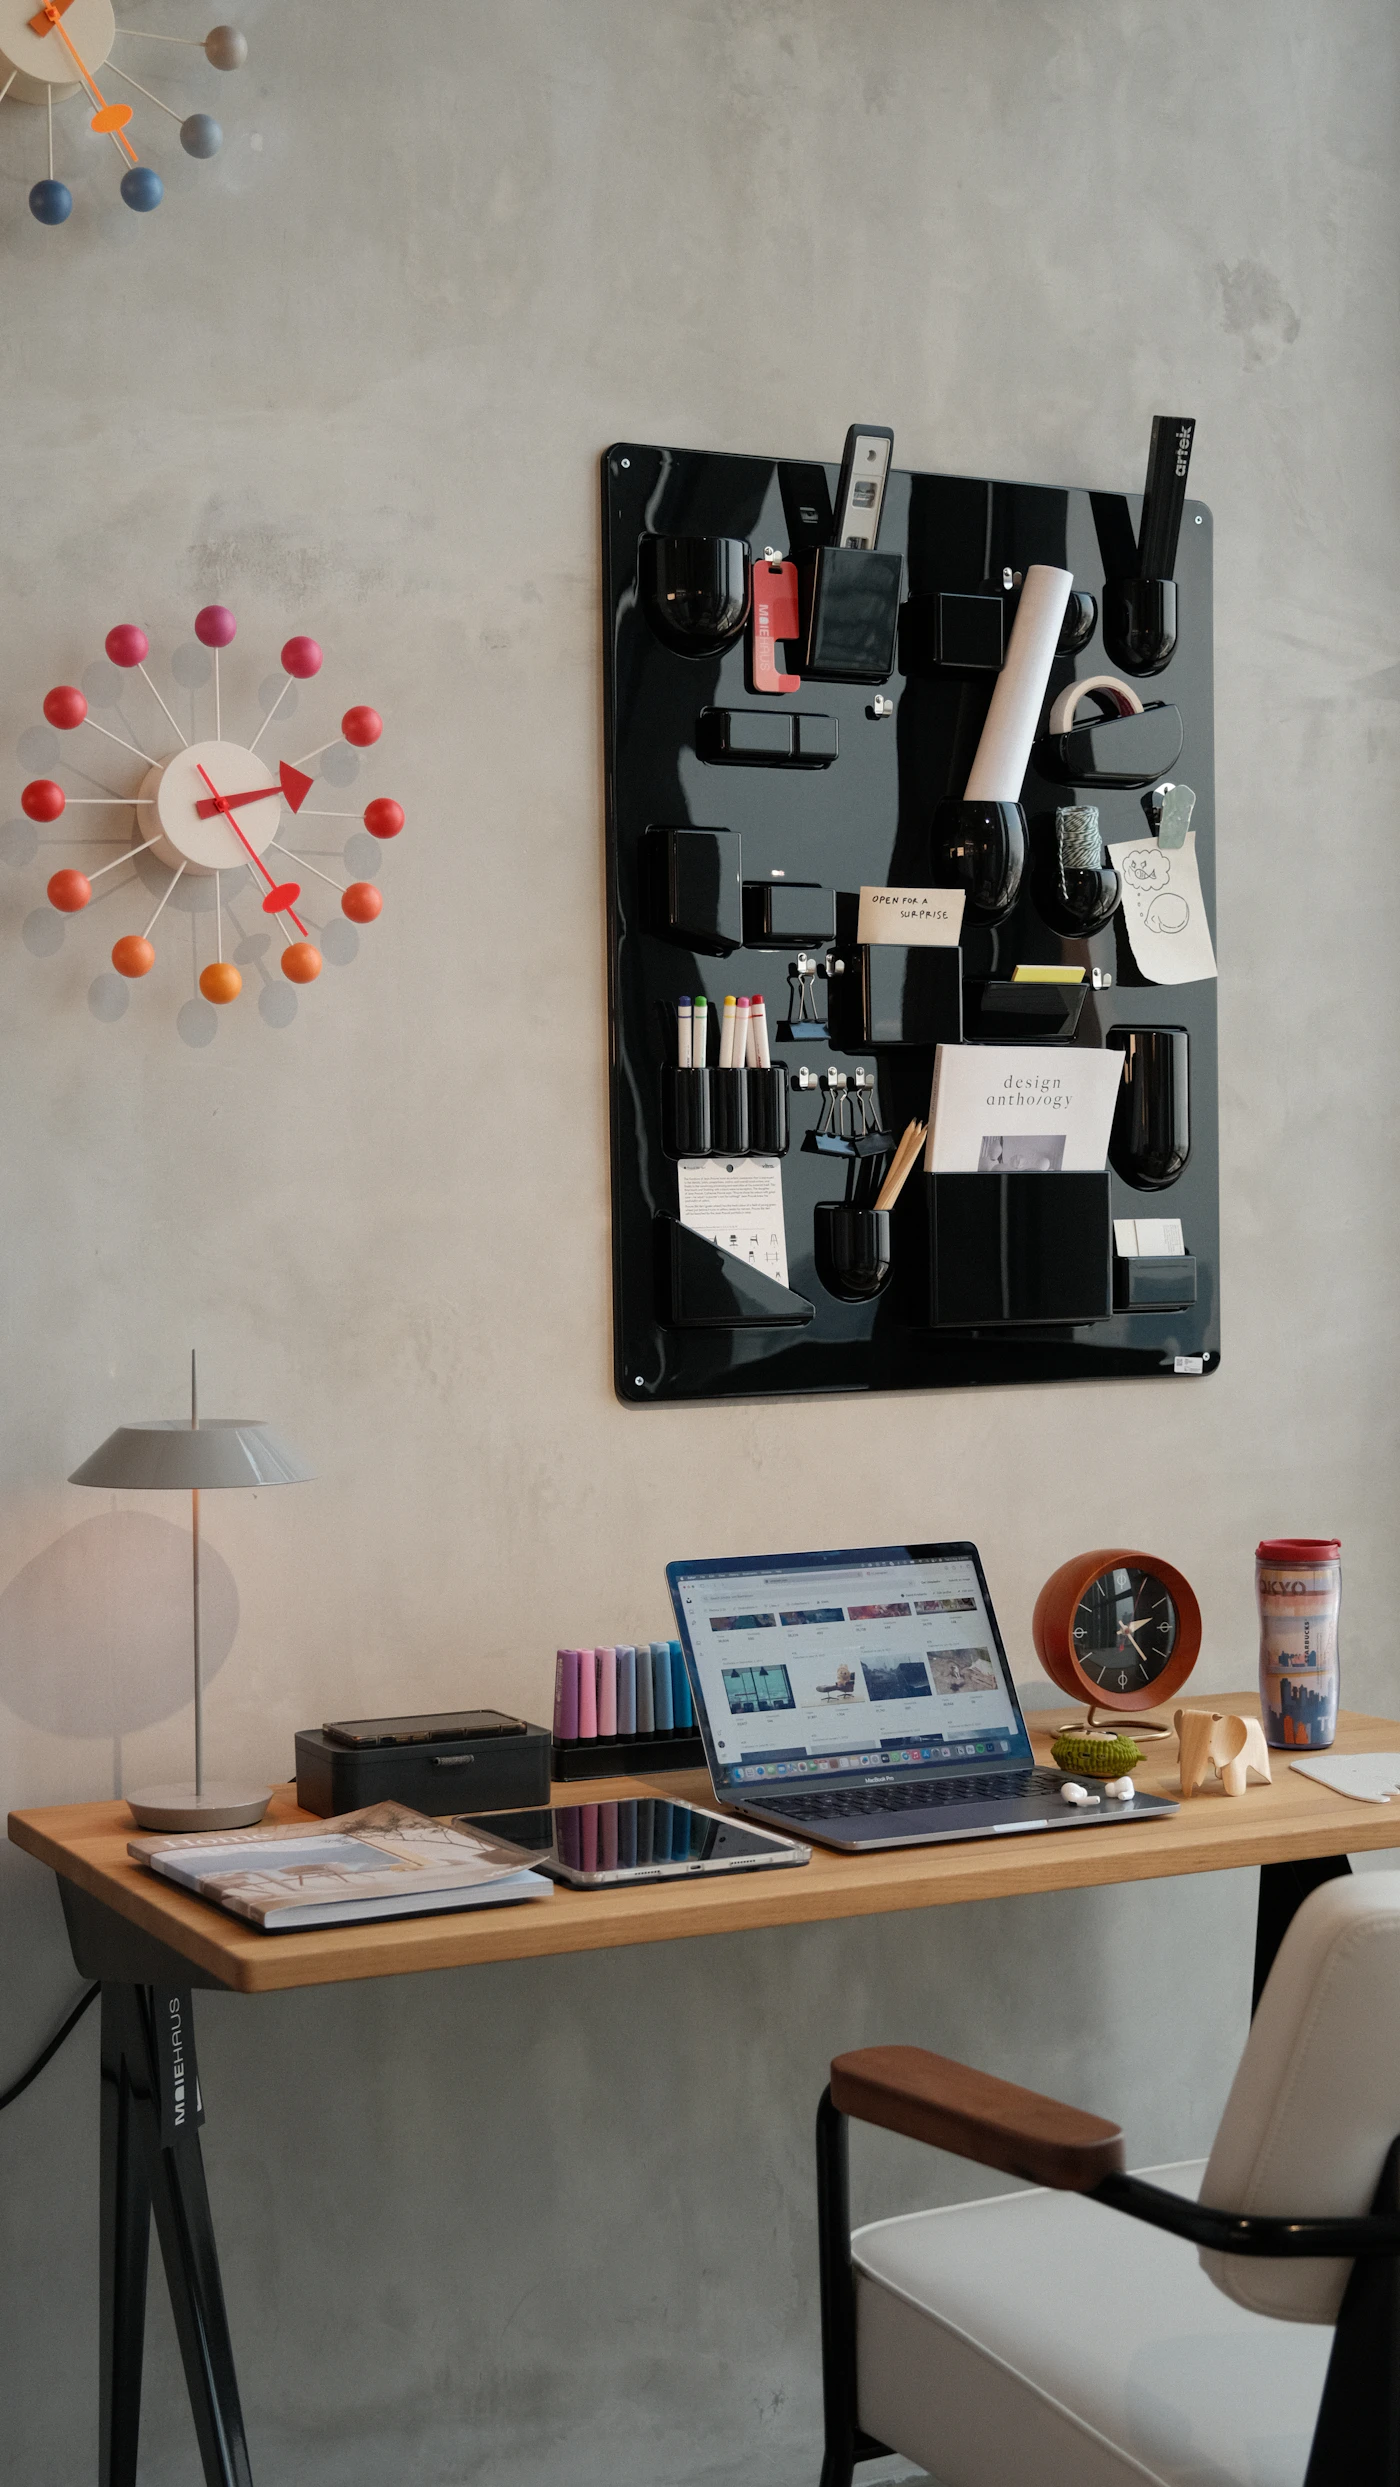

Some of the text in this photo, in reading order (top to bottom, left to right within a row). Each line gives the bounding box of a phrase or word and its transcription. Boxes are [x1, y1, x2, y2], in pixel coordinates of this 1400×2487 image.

[1175, 425, 1192, 477] artek
[871, 895, 899, 905] OPEN
[902, 897, 919, 905] FOR
[900, 910, 949, 920] SURPRISE
[1003, 1074, 1061, 1093] design
[986, 1092, 1073, 1110] anthology
[163, 1833, 273, 1848] Home
